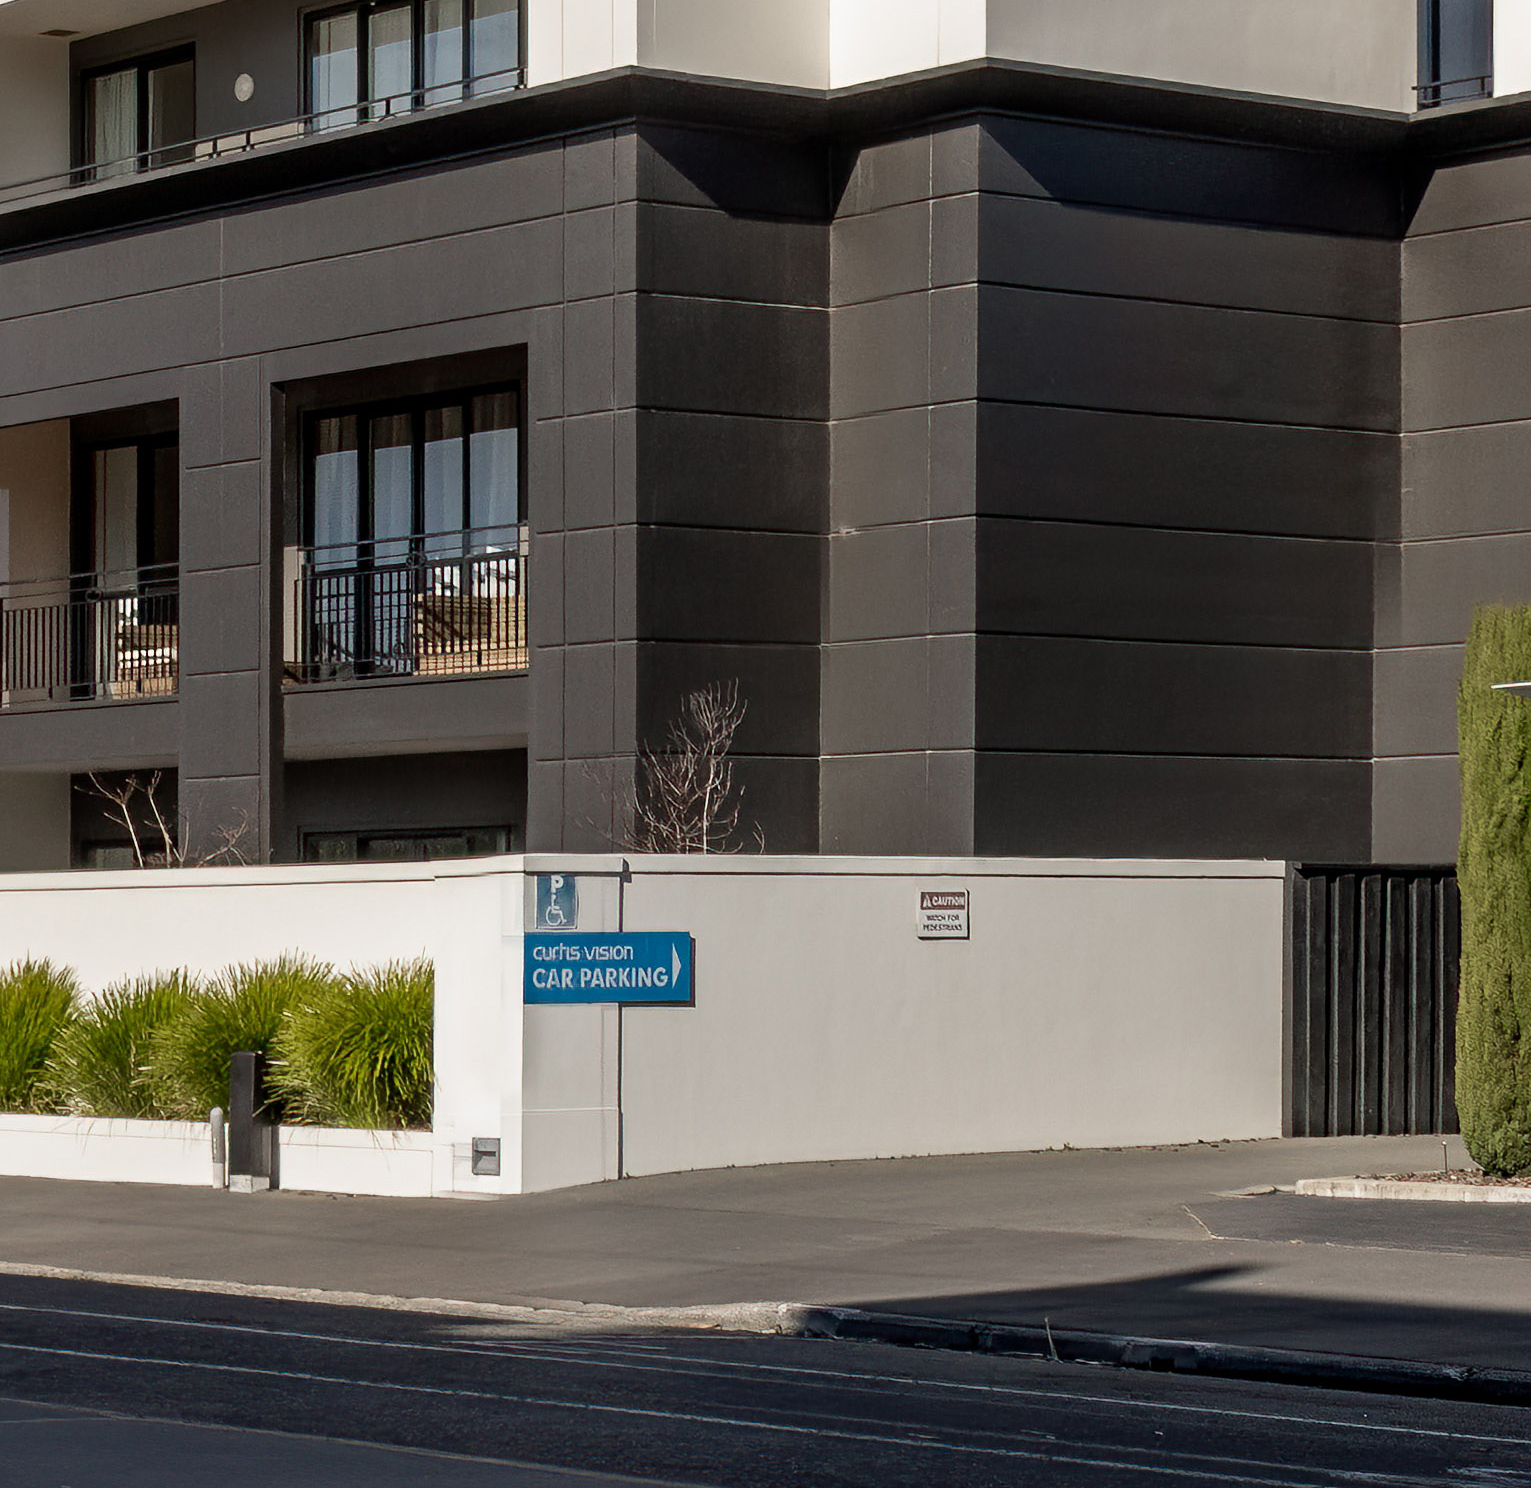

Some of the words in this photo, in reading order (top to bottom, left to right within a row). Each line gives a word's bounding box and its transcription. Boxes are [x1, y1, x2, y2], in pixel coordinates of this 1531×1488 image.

[551, 875, 564, 893] P
[534, 943, 580, 961] curtis
[584, 945, 633, 960] vision
[533, 968, 573, 989] CAR
[580, 967, 668, 988] PARKING
